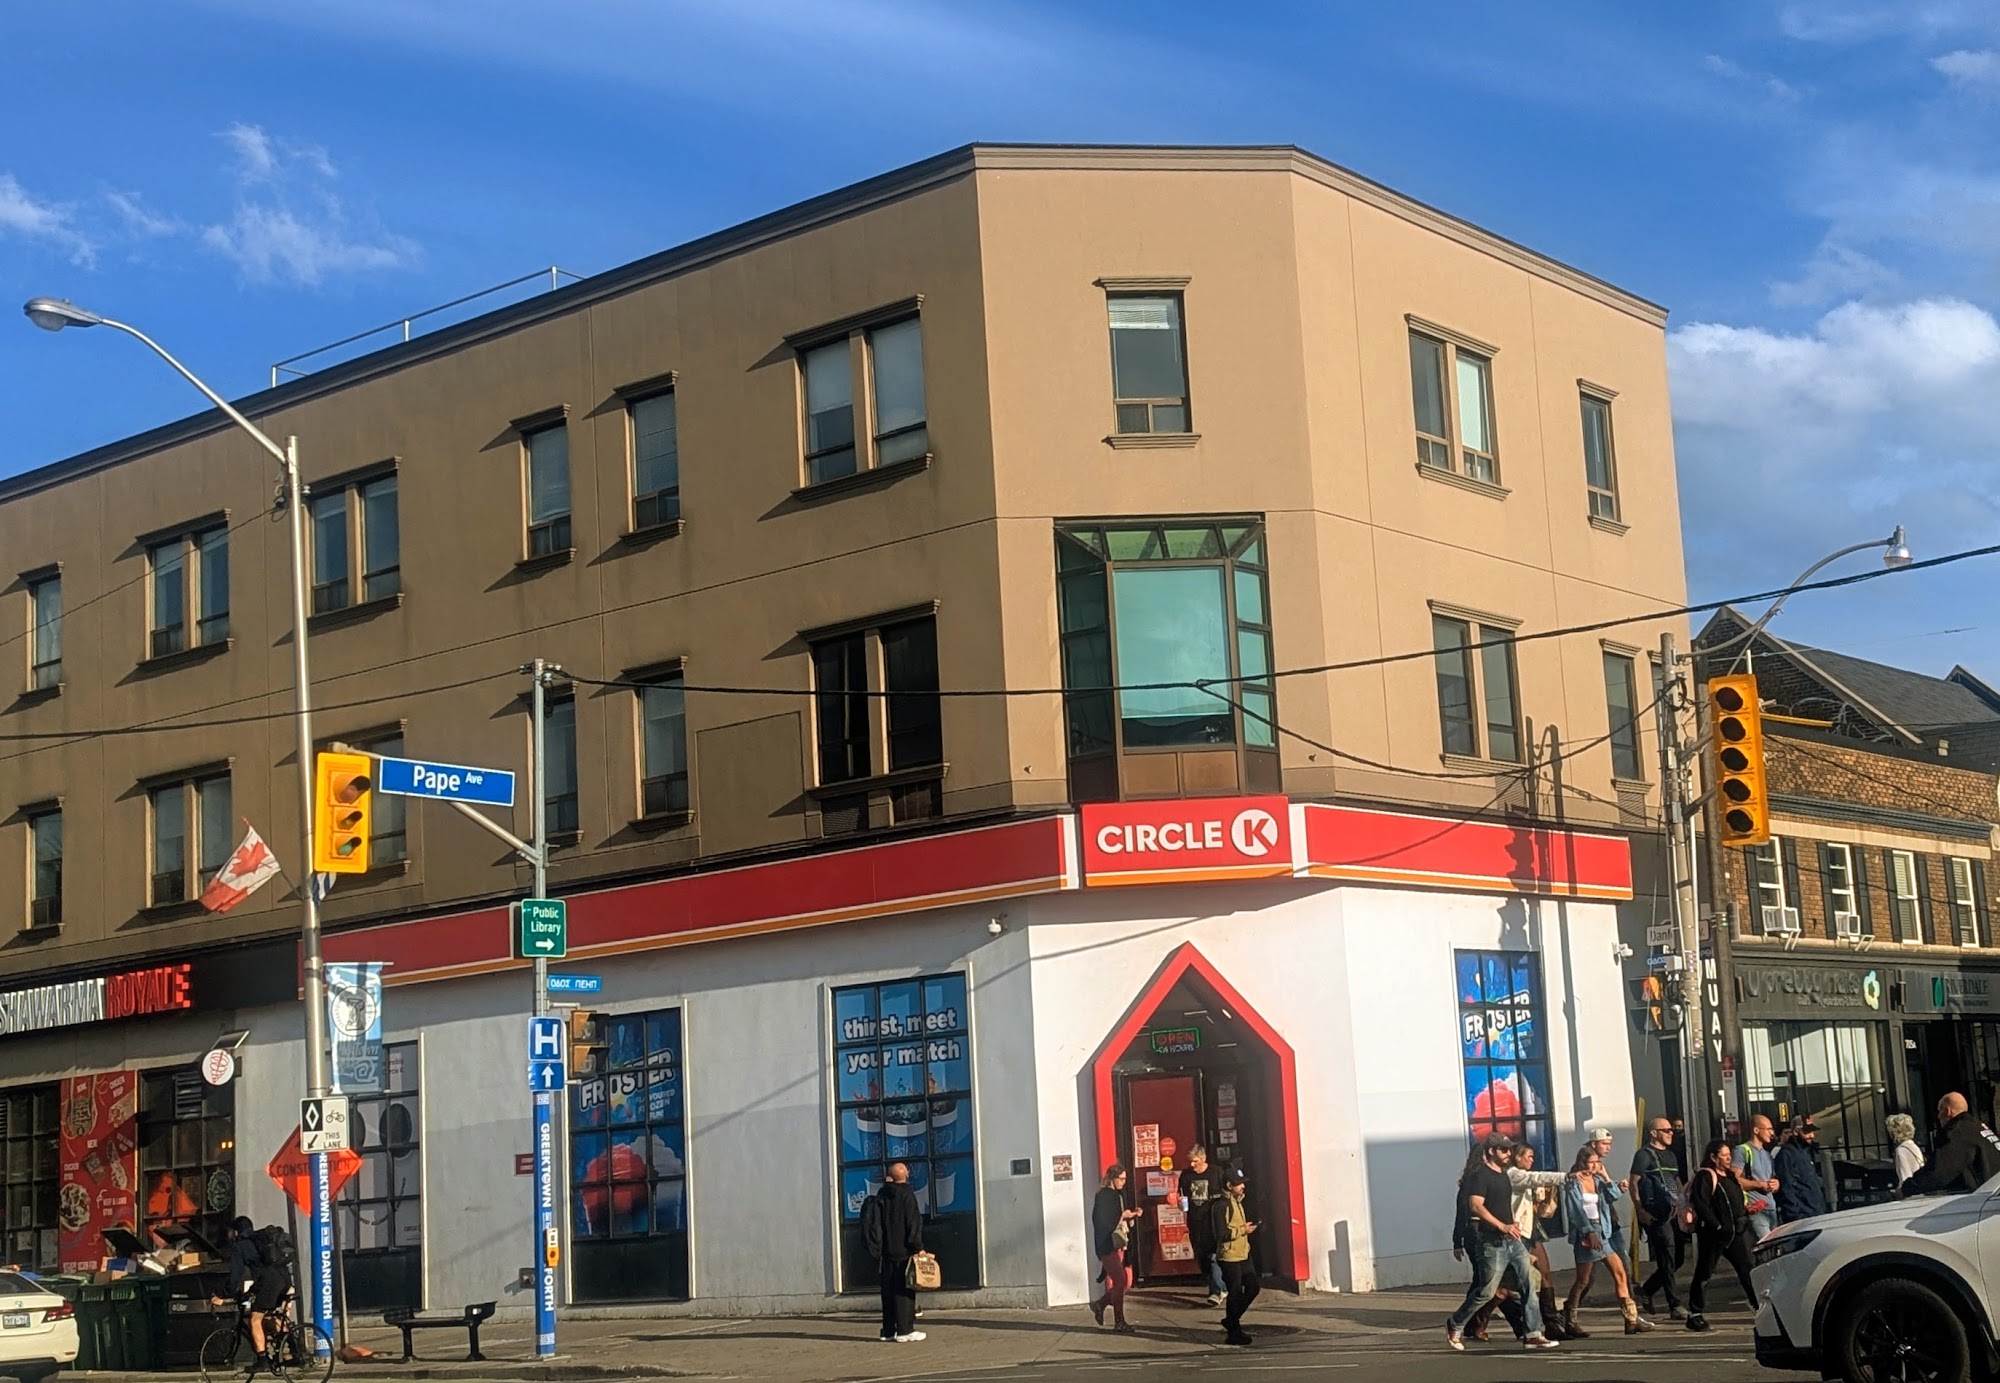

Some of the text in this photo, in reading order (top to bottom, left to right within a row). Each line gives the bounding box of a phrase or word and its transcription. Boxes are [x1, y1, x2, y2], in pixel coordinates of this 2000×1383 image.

[413, 765, 483, 795] Pape Ave
[1097, 816, 1277, 854] CIRCLE K
[531, 921, 561, 936] Library
[532, 906, 559, 919] Public
[0, 963, 191, 1035] SHAWARMA ROYALE
[1704, 958, 1723, 1062] MUAY
[844, 1008, 956, 1038] thirst, meet
[1465, 993, 1531, 1040] FROSTER
[535, 1023, 558, 1054] H
[1157, 1032, 1195, 1046] OPEN
[848, 1040, 959, 1073] your match
[581, 1051, 673, 1109] FROSTER
[323, 1141, 341, 1149] LANE
[276, 1159, 350, 1177] CONSTTION
[540, 1122, 551, 1208] GREEKTOWN
[321, 1251, 332, 1320] DANFORTH
